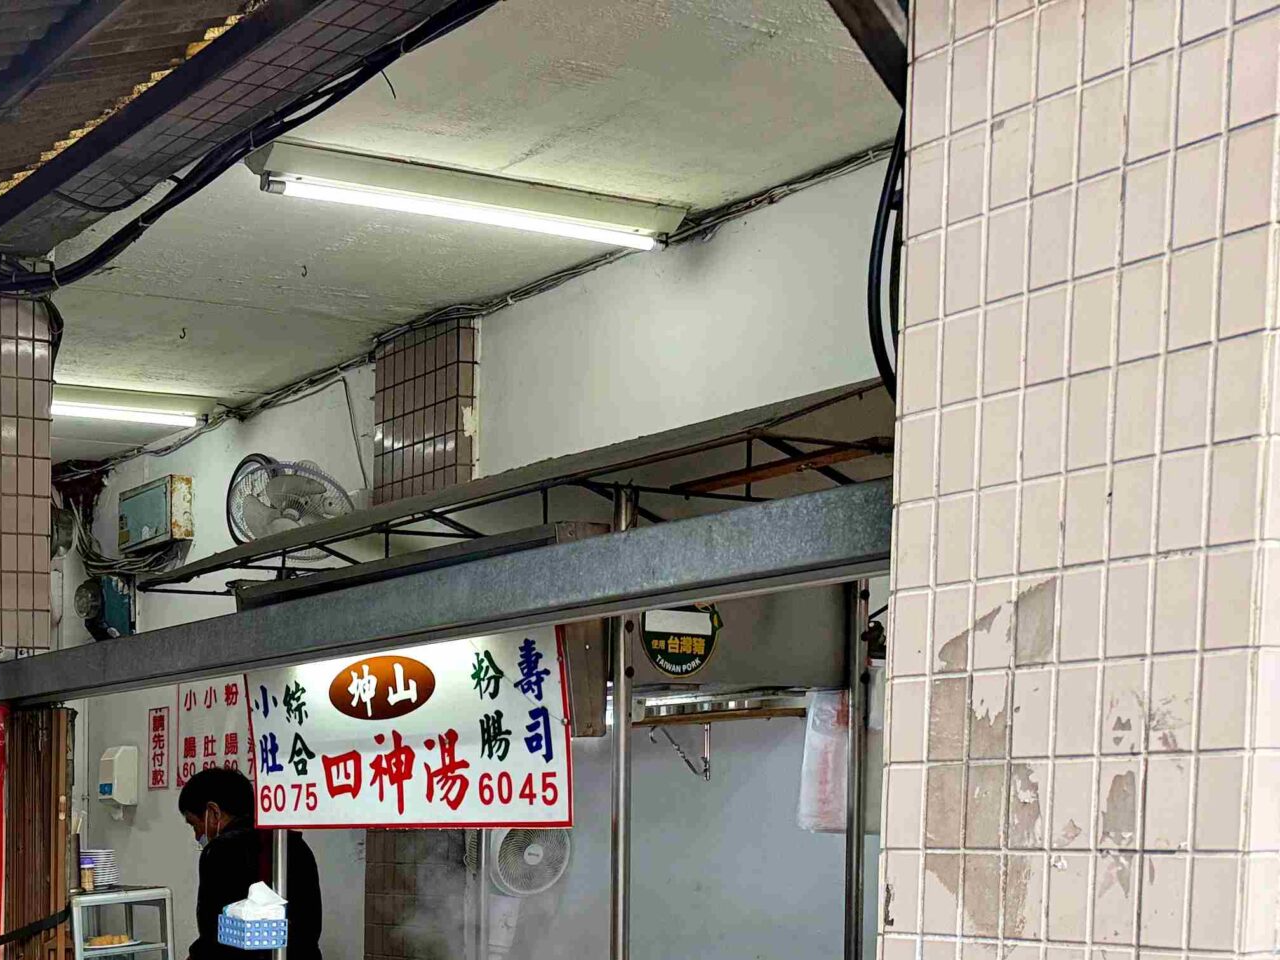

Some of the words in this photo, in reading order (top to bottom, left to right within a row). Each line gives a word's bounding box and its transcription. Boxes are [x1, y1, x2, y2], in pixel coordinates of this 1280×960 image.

[471, 648, 513, 762] 粉腸
[513, 637, 555, 764] 壽司
[656, 655, 681, 672] TAIWAN
[682, 657, 701, 672] PORK
[151, 714, 165, 786] 請先付款
[252, 685, 284, 776] 小肚
[282, 680, 317, 777] 綜合
[320, 727, 471, 816] 四神湯
